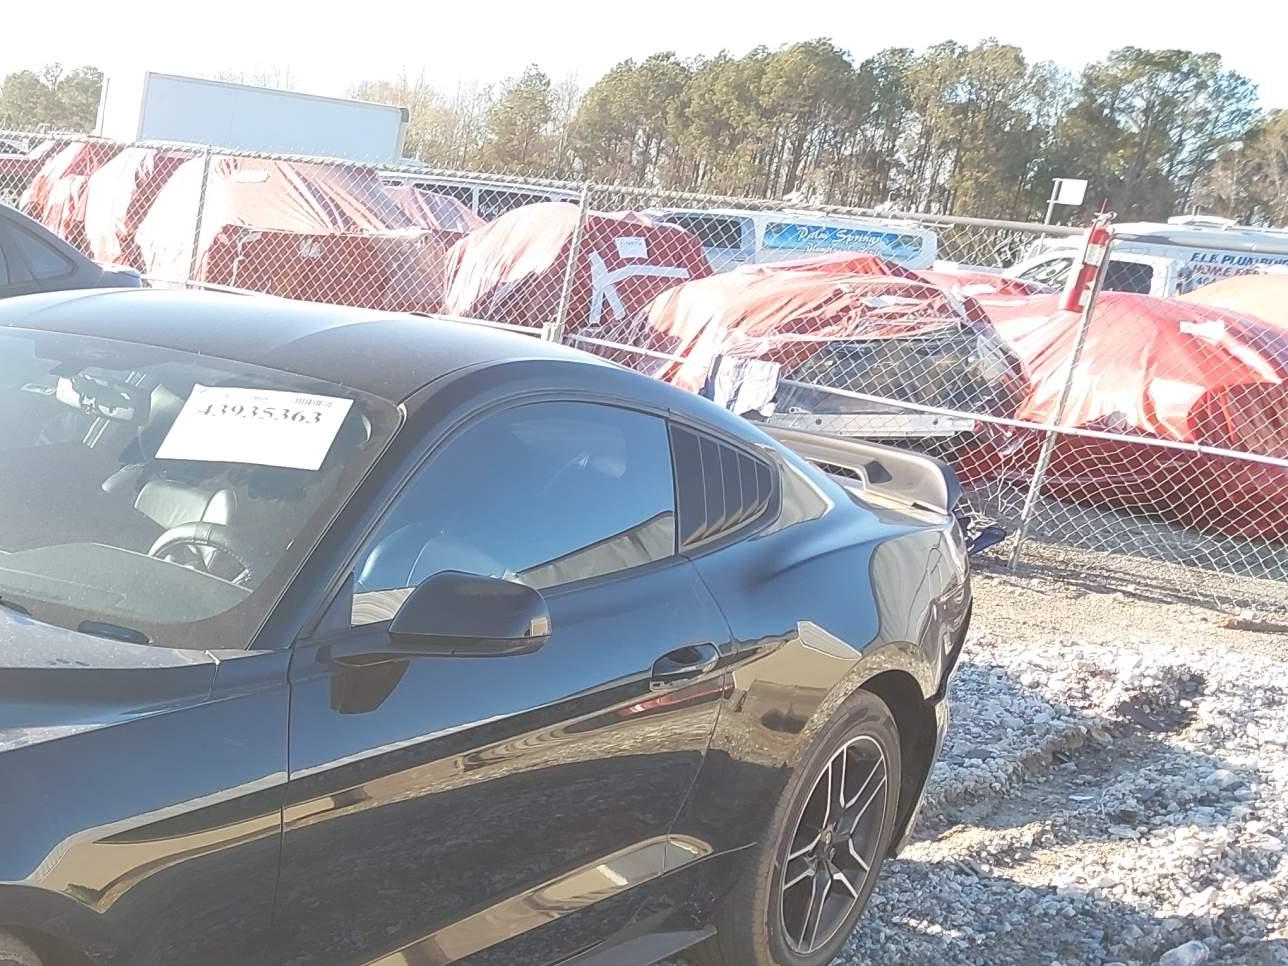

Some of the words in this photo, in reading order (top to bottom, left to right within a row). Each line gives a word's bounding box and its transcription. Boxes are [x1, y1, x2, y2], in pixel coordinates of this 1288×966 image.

[797, 226, 829, 241] Palm
[831, 229, 881, 246] Springs
[197, 402, 323, 425] 43935363
